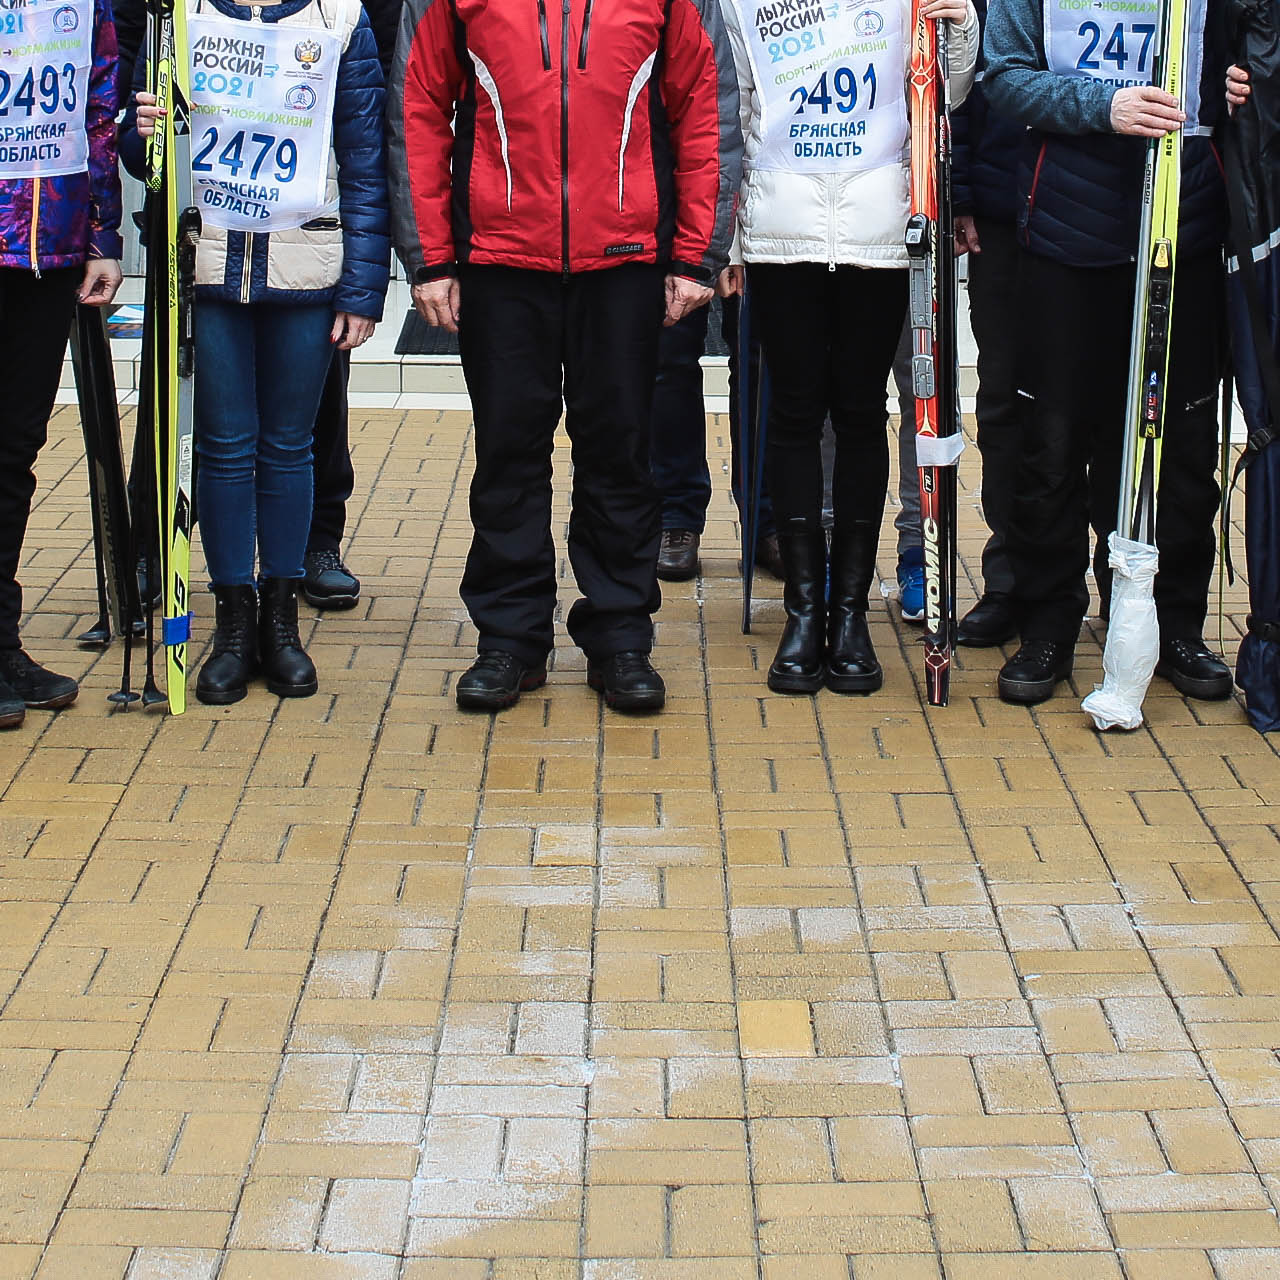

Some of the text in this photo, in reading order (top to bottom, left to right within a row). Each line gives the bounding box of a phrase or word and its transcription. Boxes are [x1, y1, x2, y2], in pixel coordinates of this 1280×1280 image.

[1059, 0, 1093, 11] СПОРТ
[760, 6, 825, 42] РОССИИ
[193, 35, 265, 60] ЛЫЖНЯ
[768, 28, 825, 64] 2021
[1076, 20, 1156, 72] 247
[193, 52, 263, 78] РОССИИ
[775, 68, 806, 86] СПОРТ
[192, 72, 254, 98] 2021
[789, 62, 877, 115] 2491
[1083, 76, 1152, 88] РЯНСК
[153, 71, 168, 158] SPOTER
[789, 121, 866, 138] БРЯНСКАЯ
[192, 127, 298, 183] 2479
[794, 143, 862, 158] ОБЛАСТЬ
[204, 188, 271, 219] ОБЛАСТЬ
[169, 243, 177, 297] FISCHER
[923, 517, 940, 634] ATOMIC
